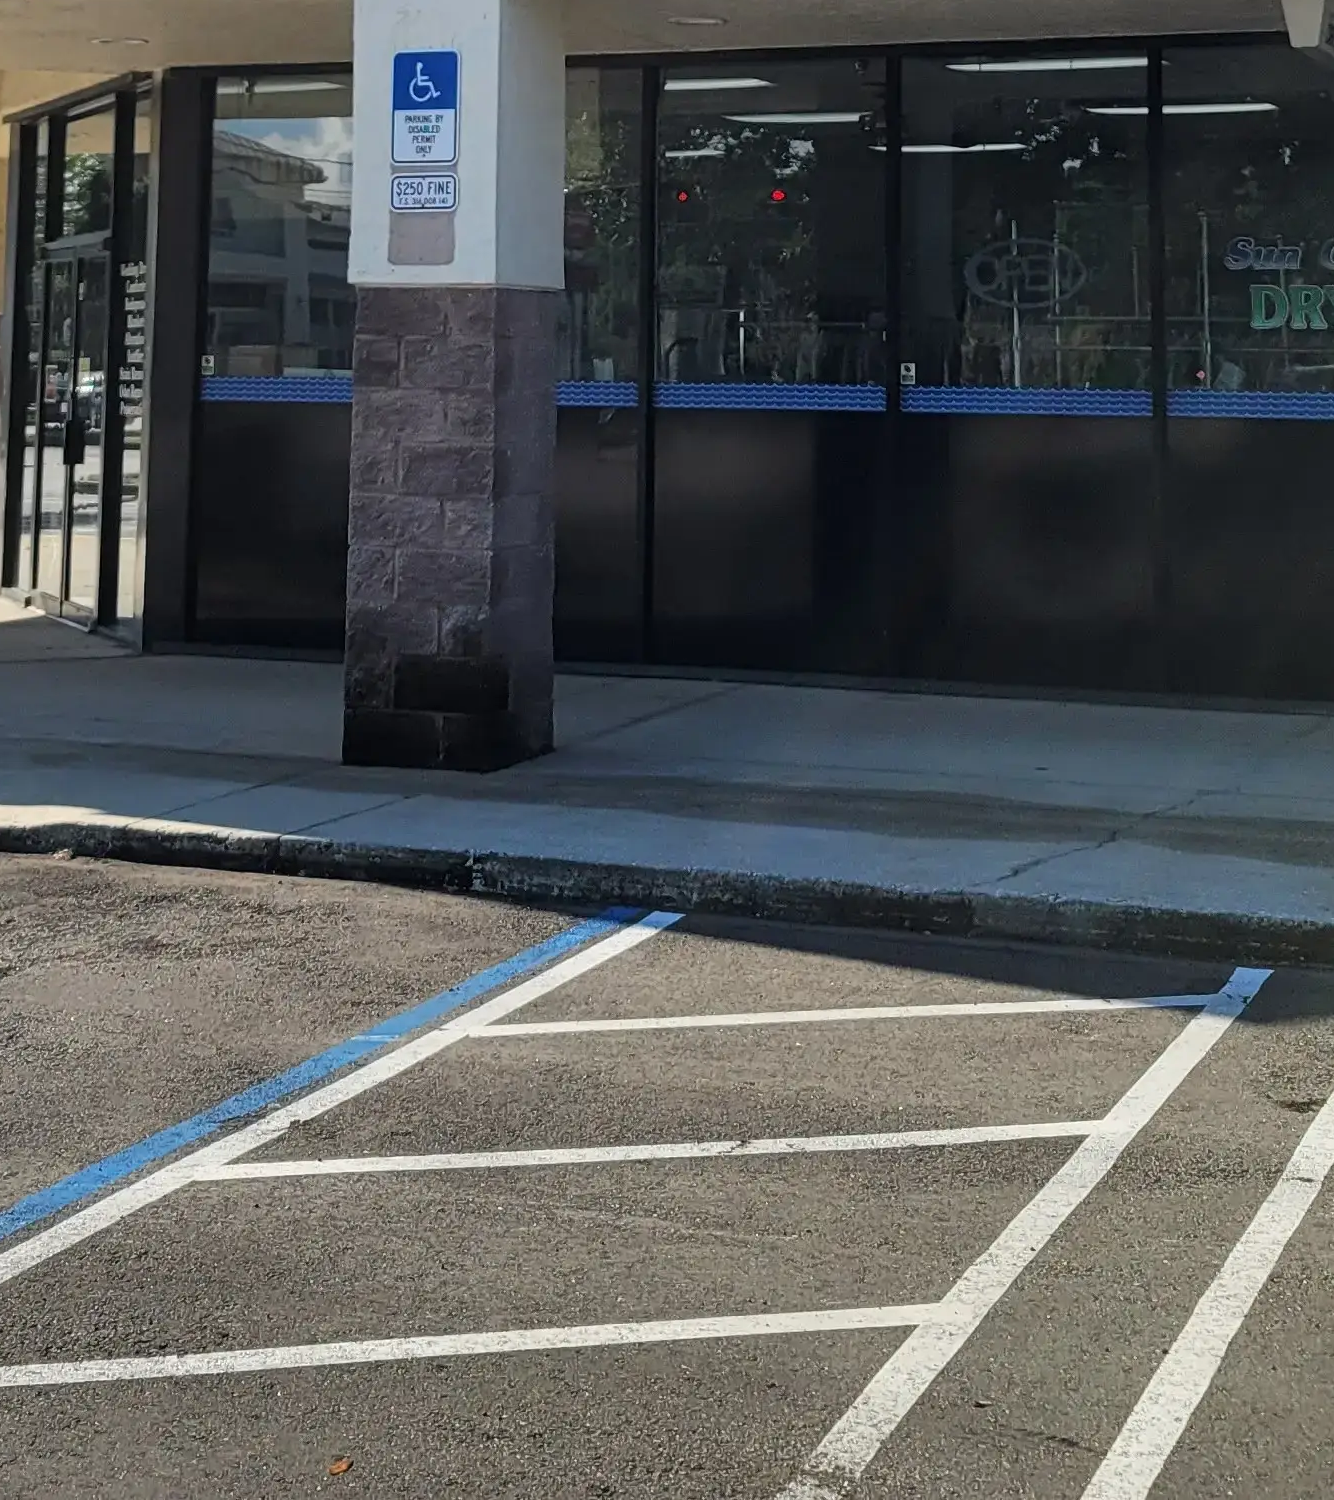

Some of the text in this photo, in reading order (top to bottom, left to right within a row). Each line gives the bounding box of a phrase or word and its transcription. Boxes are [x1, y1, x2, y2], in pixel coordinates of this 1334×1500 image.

[404, 114, 444, 123] PARKING BY
[408, 125, 441, 134] DISABLED
[412, 135, 436, 144] PERMIT
[415, 145, 432, 154] ONLY
[396, 180, 452, 197] $250 FINE
[1223, 236, 1302, 270] Sun
